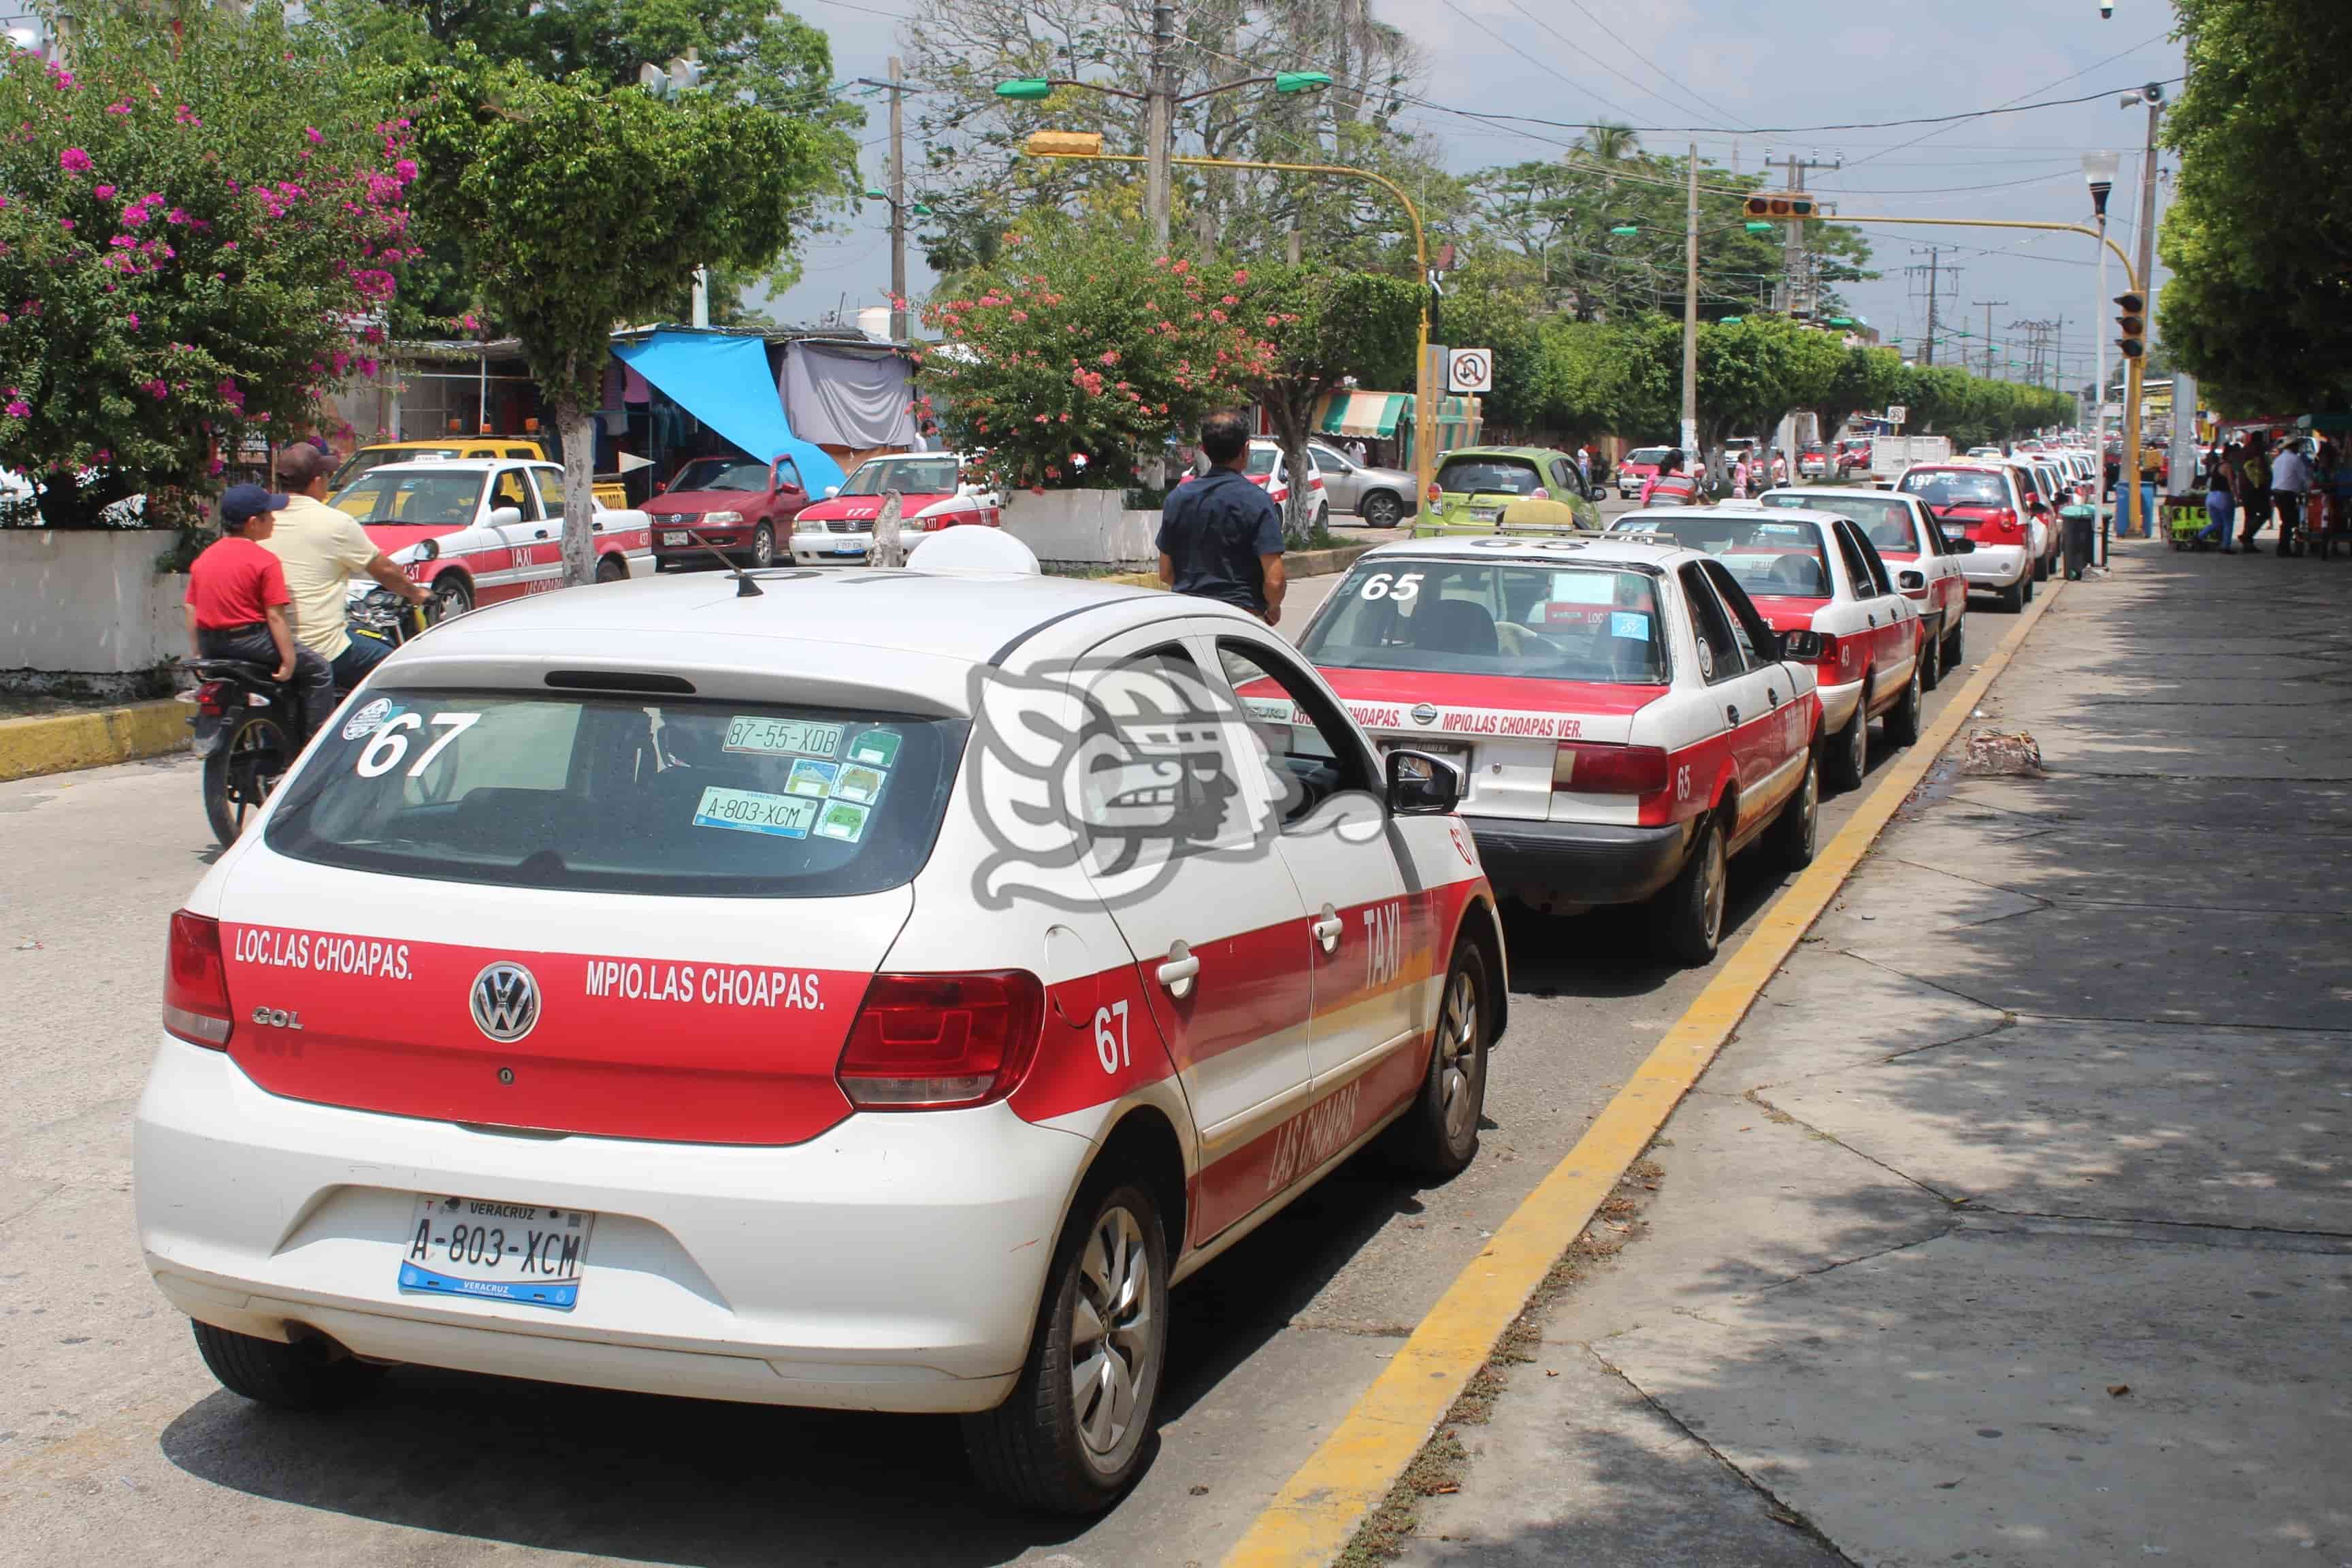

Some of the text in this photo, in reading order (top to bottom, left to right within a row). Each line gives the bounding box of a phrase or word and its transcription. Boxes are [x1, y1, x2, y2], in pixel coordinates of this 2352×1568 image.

[1908, 474, 1934, 487] 197
[846, 508, 874, 517] 177
[927, 517, 937, 529] 177
[512, 548, 532, 567] TAXI
[1361, 573, 1424, 600] 65
[1840, 644, 1850, 668] 43
[729, 723, 838, 753] 87-55-XDB
[1442, 713, 1583, 738] MPIO.LAS CHOAPAS VER.
[357, 713, 481, 777] 67
[1677, 764, 1690, 801] 65
[706, 797, 801, 828] A-803-XCM
[235, 928, 413, 981] LOC.LAS CHOAPAS.
[1363, 901, 1401, 991] TAXI
[585, 960, 825, 1011] MPIO.LAS CHOAPAS.
[252, 1006, 305, 1030] GOL
[1094, 998, 1130, 1075] 67
[1267, 1077, 1360, 1192] LAS CHOAPAS
[470, 1202, 536, 1221] VERACRUZ
[410, 1219, 581, 1277] A-803-XCM
[463, 1280, 510, 1294] VERACRUZ
